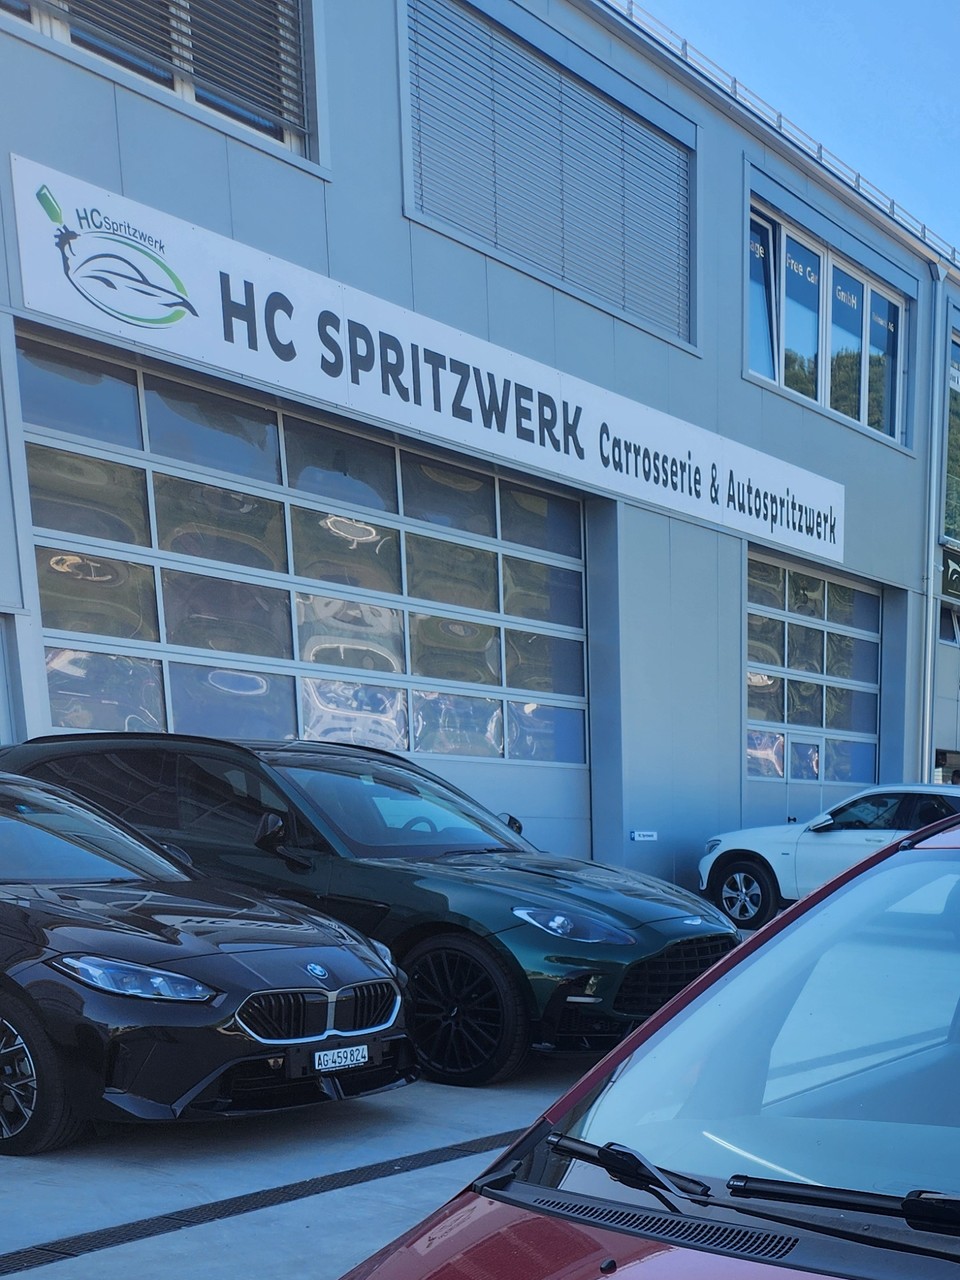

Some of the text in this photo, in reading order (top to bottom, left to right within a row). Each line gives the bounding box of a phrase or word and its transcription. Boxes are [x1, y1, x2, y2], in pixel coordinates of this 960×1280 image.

[786, 253, 803, 276] Free
[836, 286, 857, 310] GmbH
[219, 271, 837, 545] HC SPRITZWERK Carrosserie & Autospritzwerk
